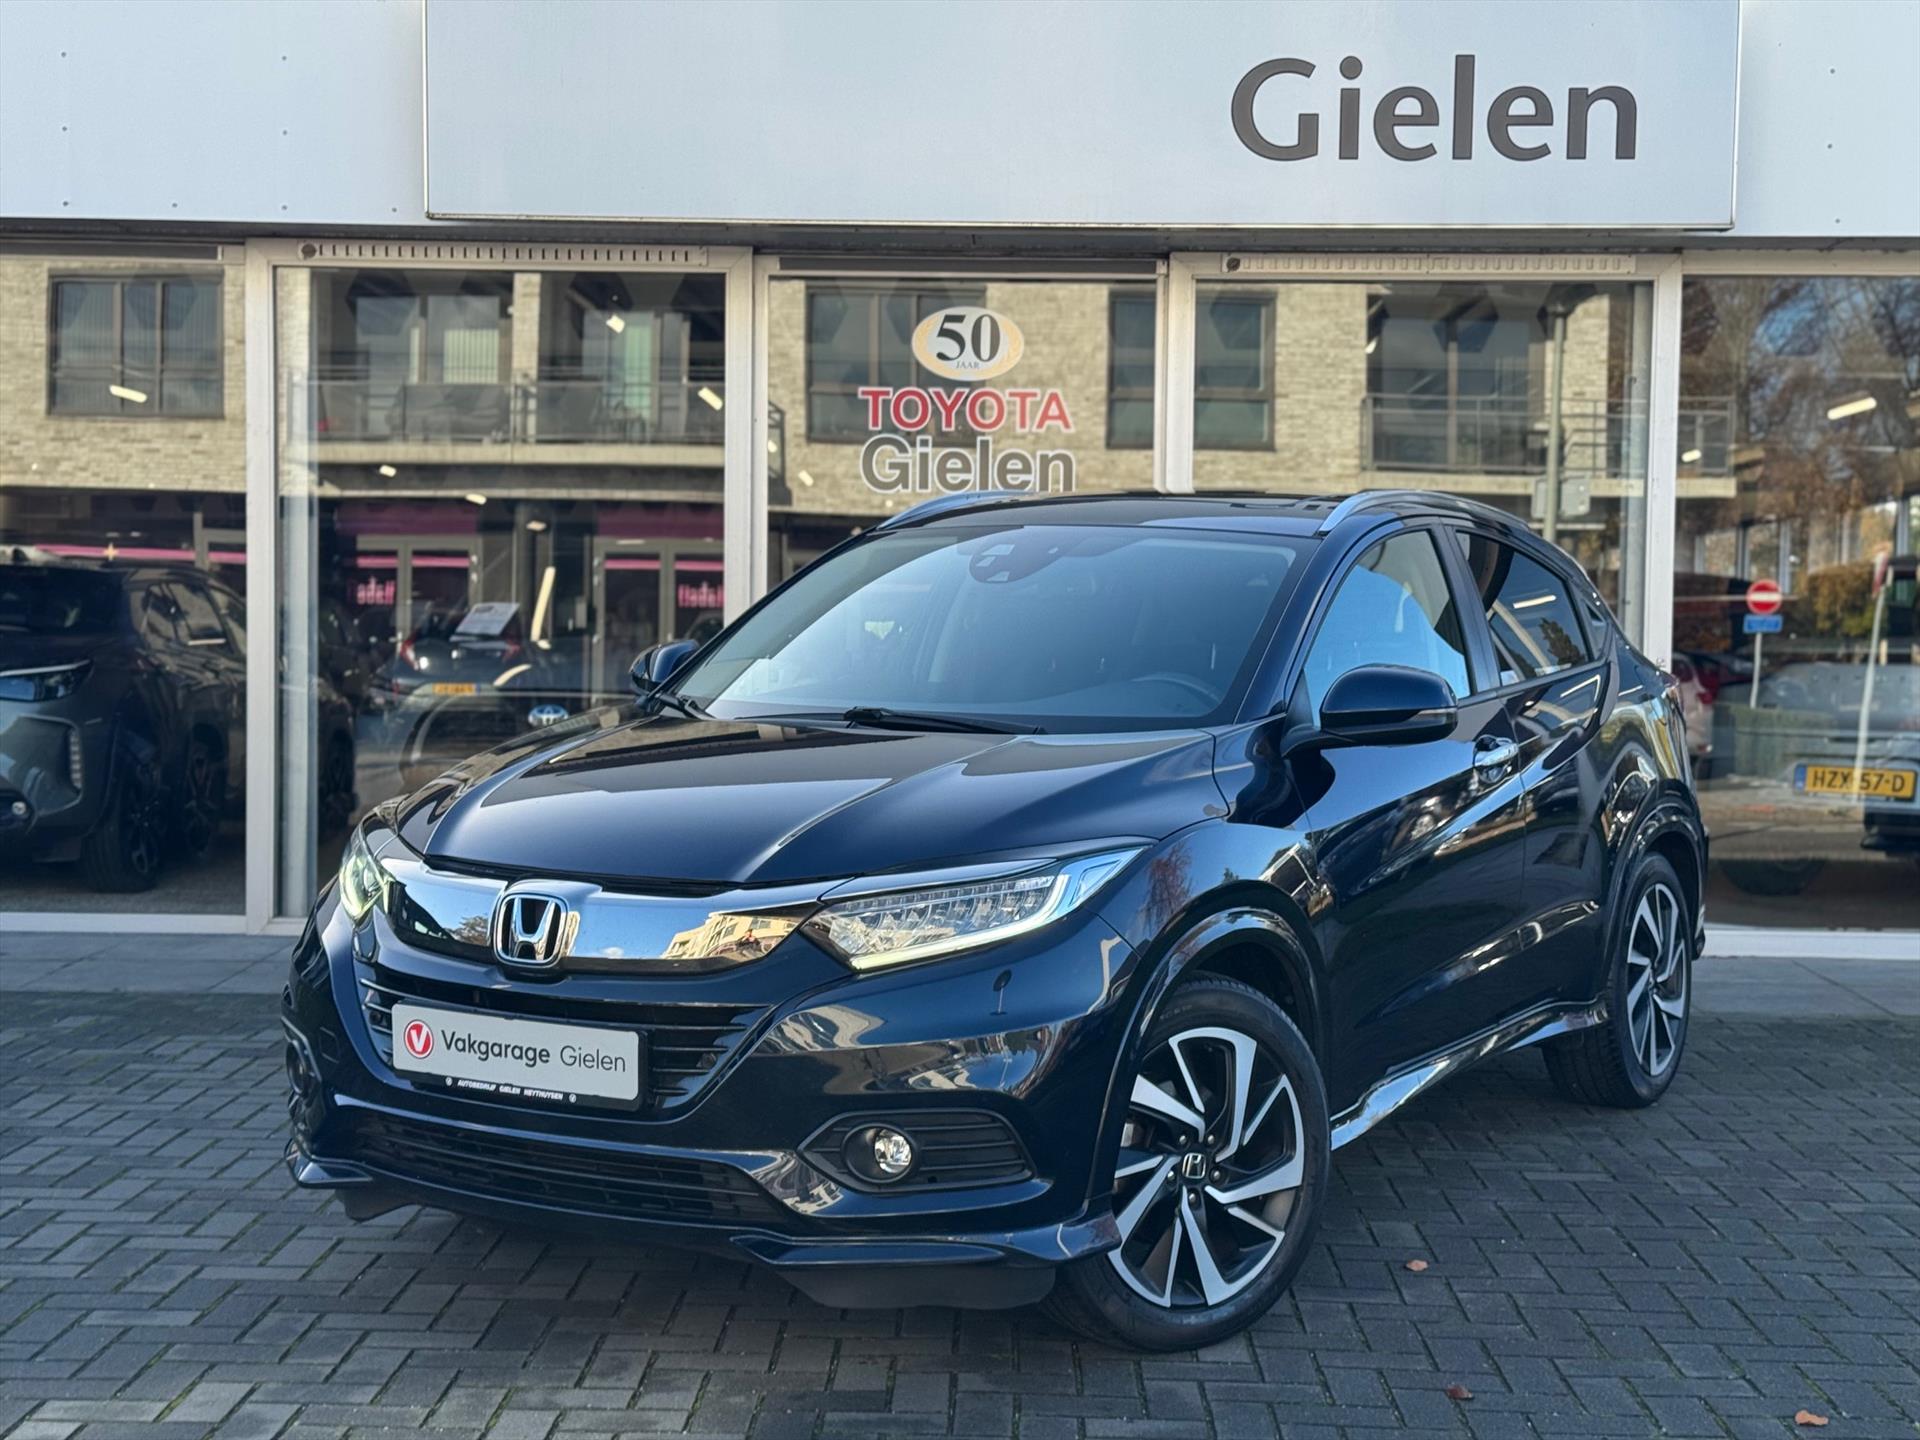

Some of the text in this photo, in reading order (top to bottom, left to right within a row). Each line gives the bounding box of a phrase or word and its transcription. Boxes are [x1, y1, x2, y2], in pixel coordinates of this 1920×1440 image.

[1231, 54, 1637, 162] Gielen
[936, 314, 1001, 362] 50
[955, 360, 981, 370] JAAR
[858, 387, 1074, 432] TOYOTA
[861, 434, 1076, 493] Gielen
[1812, 769, 1905, 792] HZX57-D
[441, 1029, 626, 1073] Vakgarage Gielen
[499, 1085, 521, 1095] GIELEN
